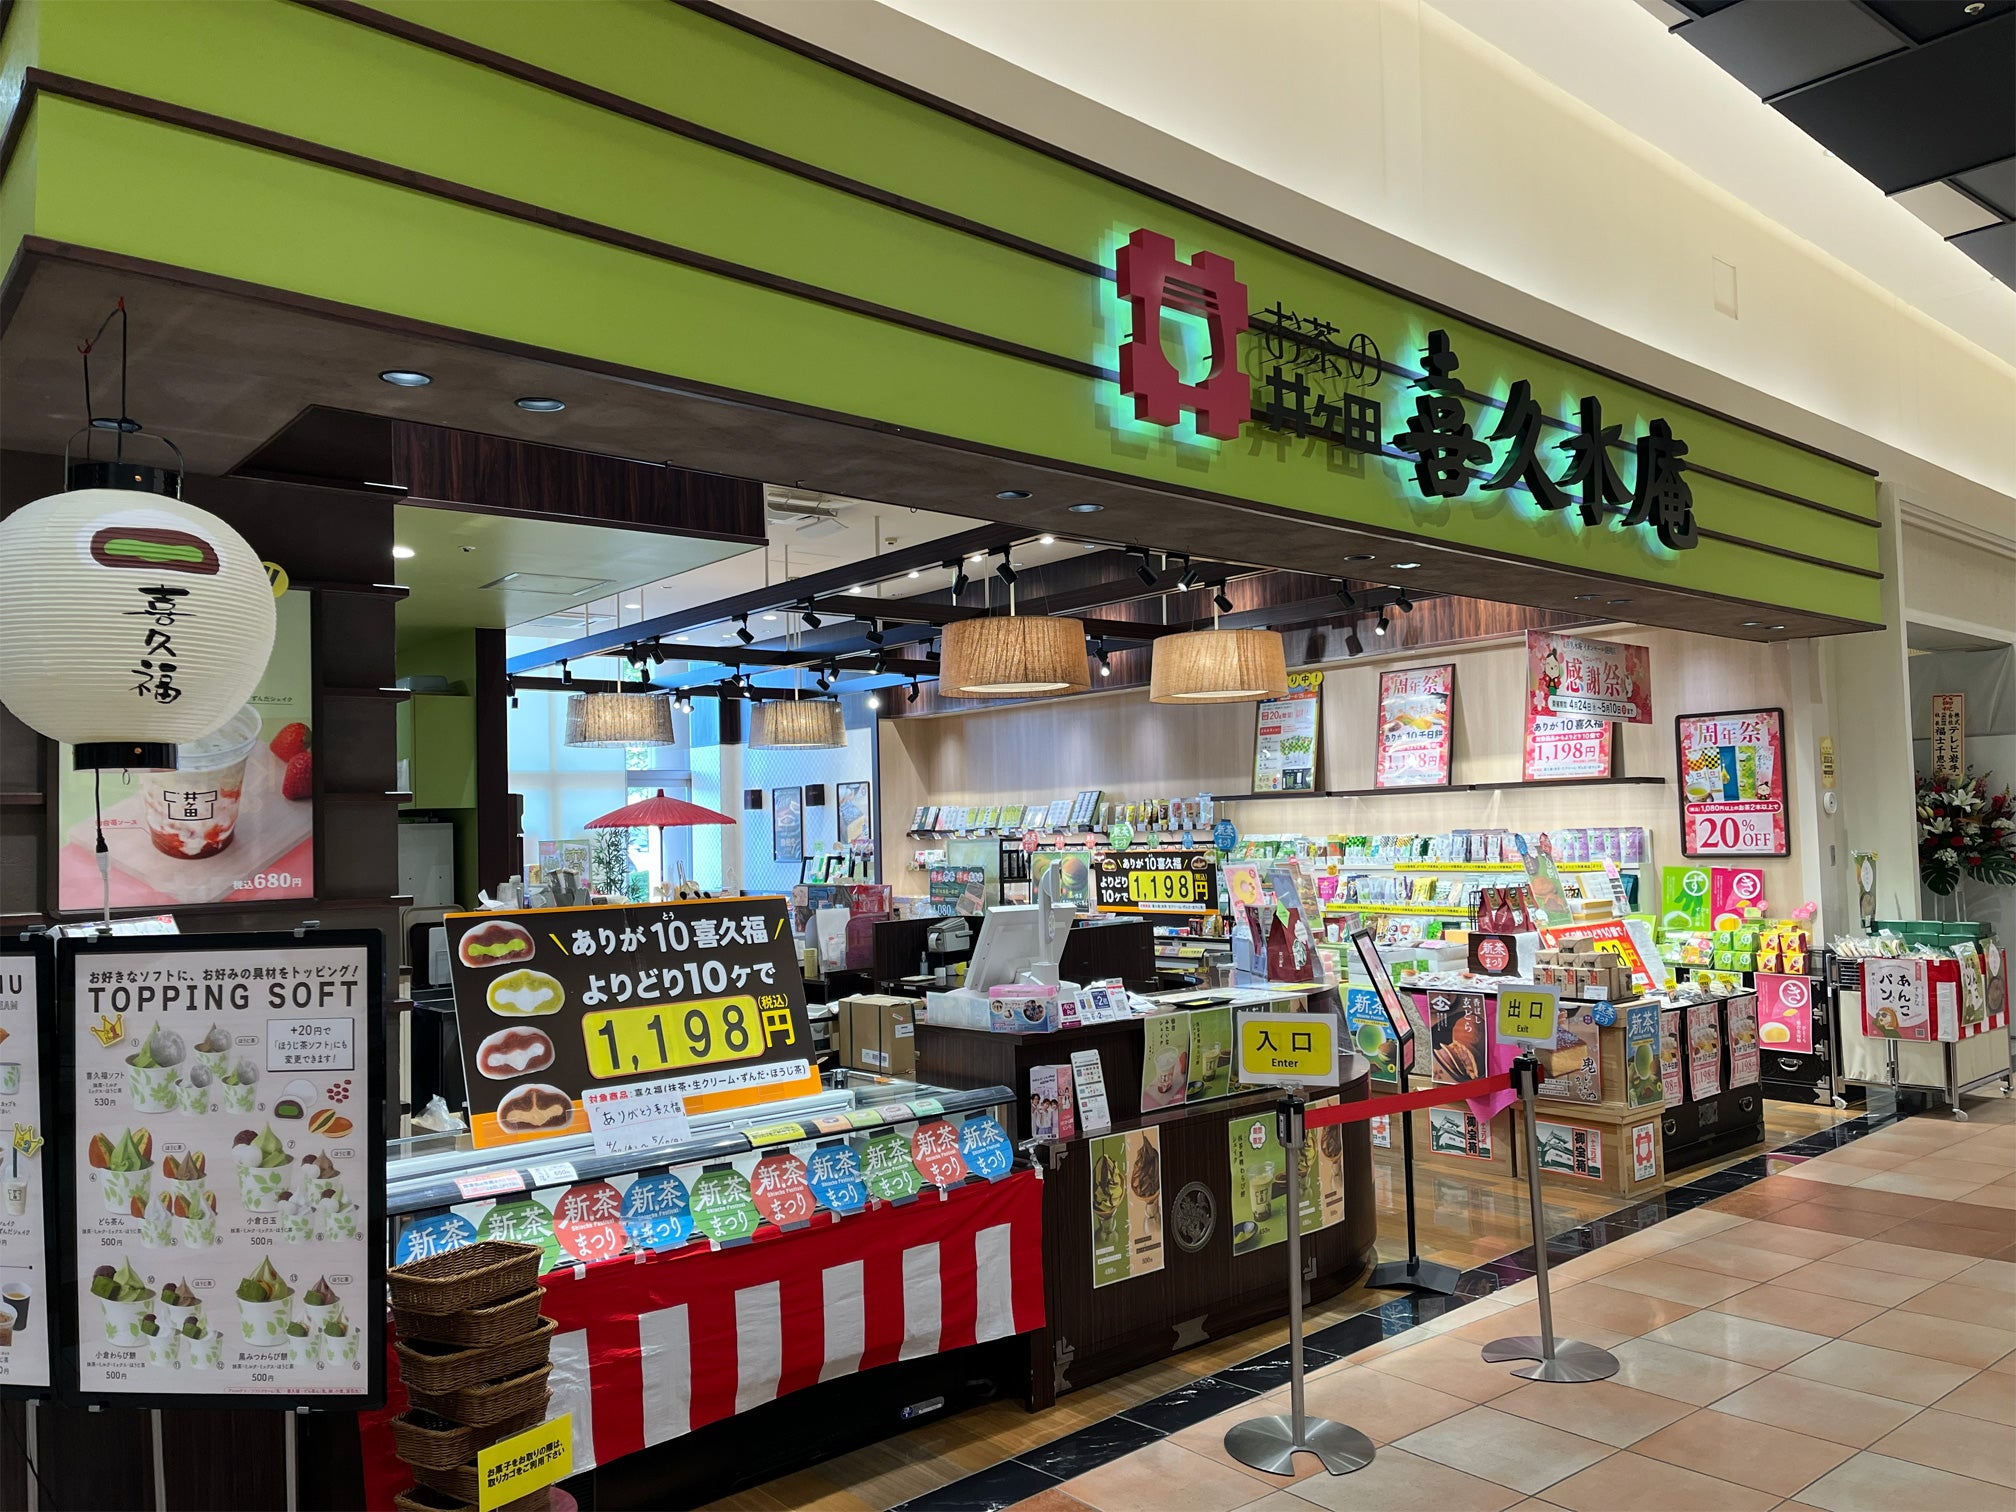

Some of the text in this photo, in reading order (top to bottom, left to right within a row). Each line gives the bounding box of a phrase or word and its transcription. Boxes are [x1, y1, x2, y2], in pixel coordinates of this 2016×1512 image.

[1256, 302, 1382, 385] お茶の
[1398, 330, 1698, 550] 喜久水庵
[122, 584, 196, 704] 喜久福
[1565, 658, 1622, 697] 感謝祭
[1697, 721, 1761, 746] 周年祭
[1537, 742, 1596, 763] 1,198円
[1742, 833, 1771, 847] OFF
[1100, 876, 1129, 888] よりどり
[1134, 875, 1189, 900] 1,198
[1195, 881, 1208, 900] 円
[662, 911, 675, 920] とう
[571, 915, 768, 957] ありが10喜久福
[1481, 942, 1506, 956] 新茶
[1485, 958, 1502, 967] まつり
[582, 960, 775, 1005] よりどり10ケで
[1879, 973, 1893, 1001] パン
[1897, 974, 1911, 1017] あんこ
[88, 981, 359, 1013] TOPPING SOFT
[1507, 999, 1543, 1019] 出口
[1462, 997, 1472, 1033] 玄どら
[1473, 998, 1482, 1024] 香ばし
[1629, 1011, 1655, 1037] 新茶
[598, 1004, 795, 1072] 1,198 円
[1256, 1031, 1312, 1053] 入口
[1517, 1025, 1529, 1033] Exit
[1271, 1058, 1299, 1068] Enter
[94, 1098, 116, 1106] 530円
[916, 1125, 959, 1161] 新茶
[963, 1120, 1004, 1155] 新茶
[1467, 1116, 1478, 1153] 御宝箱
[865, 1138, 913, 1174] 新茶
[976, 1150, 1007, 1175] まつり
[1575, 1131, 1586, 1173] 御宝箱
[754, 1162, 808, 1196] 新茶
[811, 1152, 858, 1189] 新茶
[930, 1157, 960, 1182] まつり
[694, 1172, 752, 1212] 新茶
[880, 1171, 913, 1195] まつり
[558, 1187, 622, 1229] 新茶
[625, 1180, 685, 1220] 新茶
[770, 1193, 806, 1221] まつり
[826, 1185, 858, 1208] まつり
[246, 1217, 277, 1225] 小倉白玉
[487, 1207, 551, 1243] 新茶
[710, 1211, 749, 1237] まつり
[100, 1237, 123, 1247] 500円
[250, 1236, 273, 1246] 500円
[574, 1227, 617, 1257] まつり
[105, 1370, 128, 1380] 500円
[251, 1373, 274, 1382] 500円
